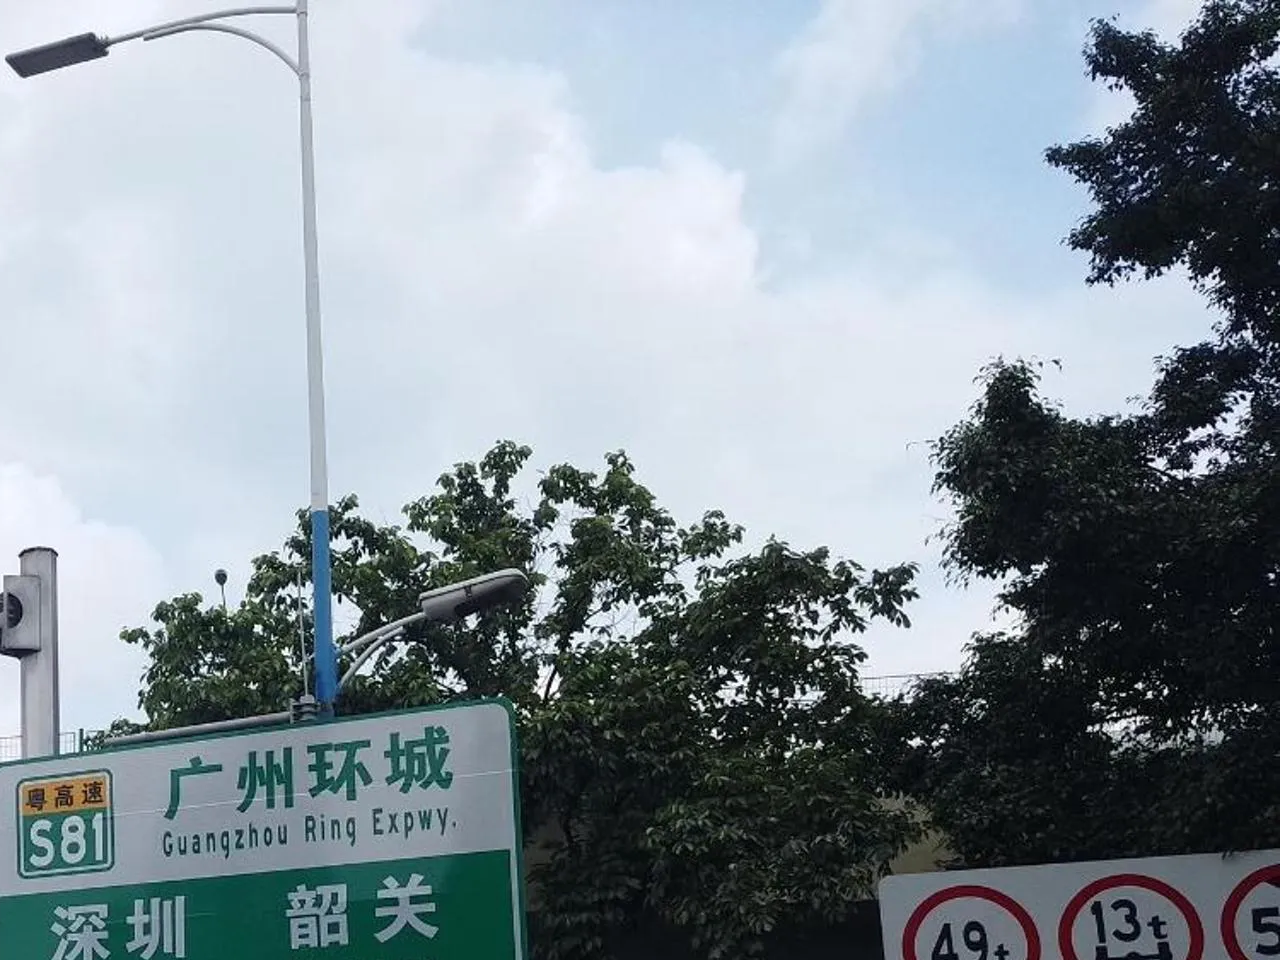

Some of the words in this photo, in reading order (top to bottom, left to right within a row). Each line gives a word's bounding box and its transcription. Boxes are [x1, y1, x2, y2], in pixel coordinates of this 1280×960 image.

[25, 781, 105, 811] 粤高速
[162, 725, 454, 821] 广州环城
[29, 812, 105, 867] S81
[162, 819, 289, 860] Guangzhou
[304, 812, 358, 847] Ring
[372, 805, 458, 840] Expwy.
[285, 872, 440, 951] 韶关
[1090, 899, 1168, 944] 13t
